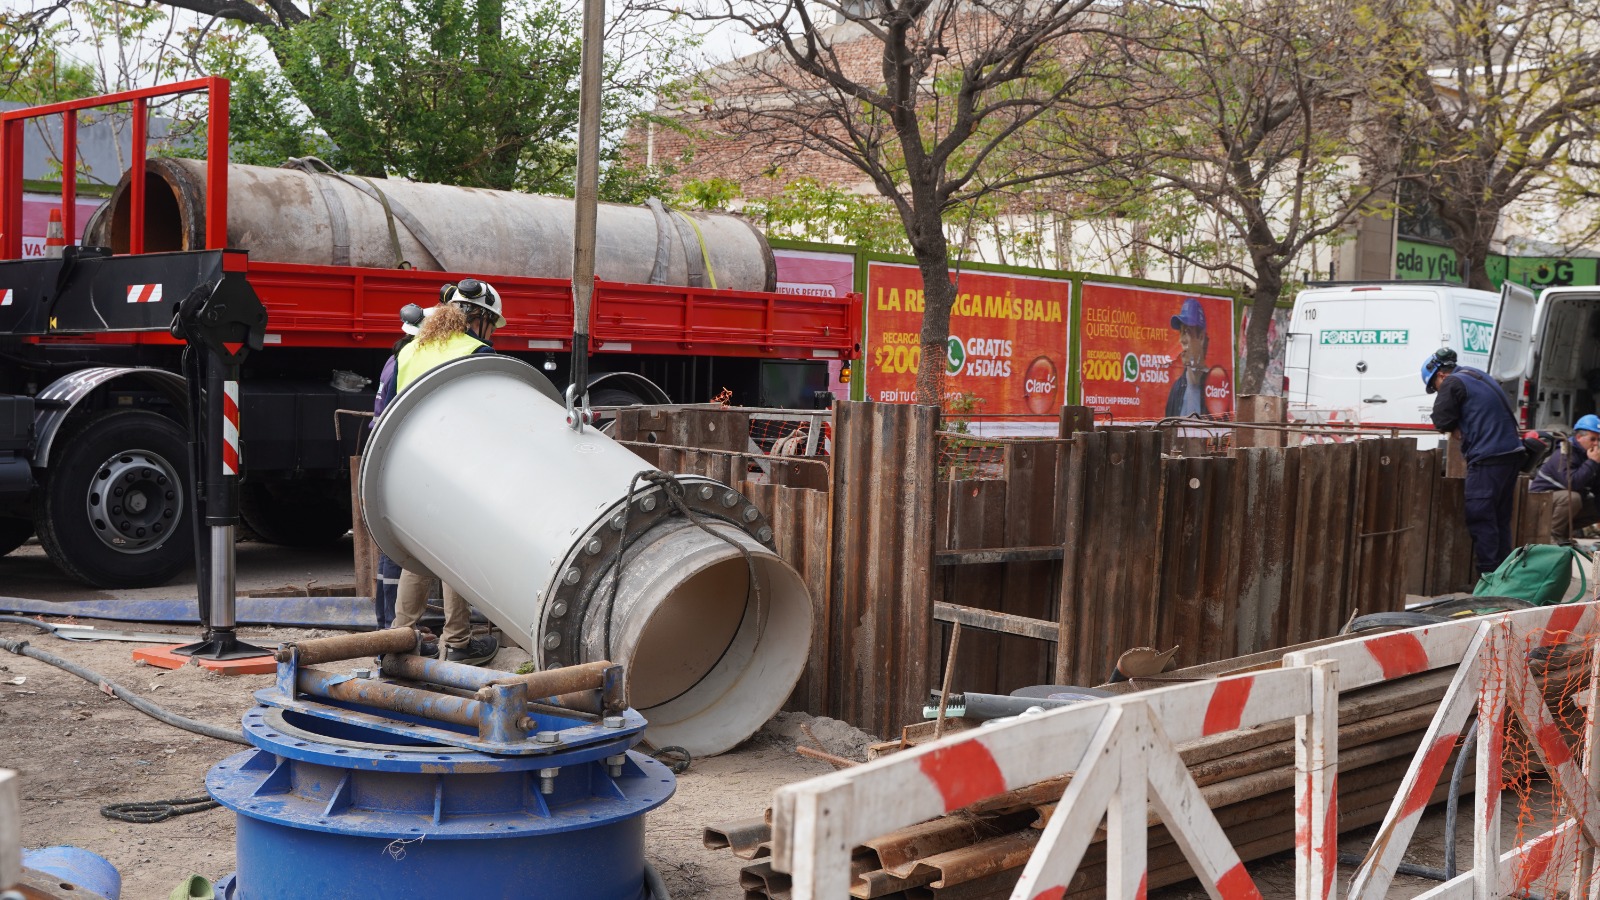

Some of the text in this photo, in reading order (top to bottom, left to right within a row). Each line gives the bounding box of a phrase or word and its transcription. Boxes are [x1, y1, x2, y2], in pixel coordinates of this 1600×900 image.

[1427, 256, 1436, 279] y
[1438, 253, 1458, 277] Gu
[877, 287, 901, 311] LA
[985, 290, 1022, 321] MÁS
[1023, 299, 1062, 322] BAJA
[1087, 306, 1110, 322] ELEGÍ
[1305, 308, 1316, 320] 110
[883, 332, 921, 344] RECARGA
[1119, 325, 1169, 341] CONECTARTE
[1321, 331, 1406, 344] FOREVER PIPE
[966, 338, 1012, 357] GRATIS
[1087, 350, 1121, 360] RECARGANDO
[1140, 354, 1170, 368] GRATIS
[1083, 359, 1121, 381] $2000
[1025, 377, 1053, 393] Claro
[1205, 384, 1227, 398] Claro
[880, 388, 898, 402] PEDÍ
[899, 391, 910, 402] TU
[1098, 396, 1104, 404] TU
